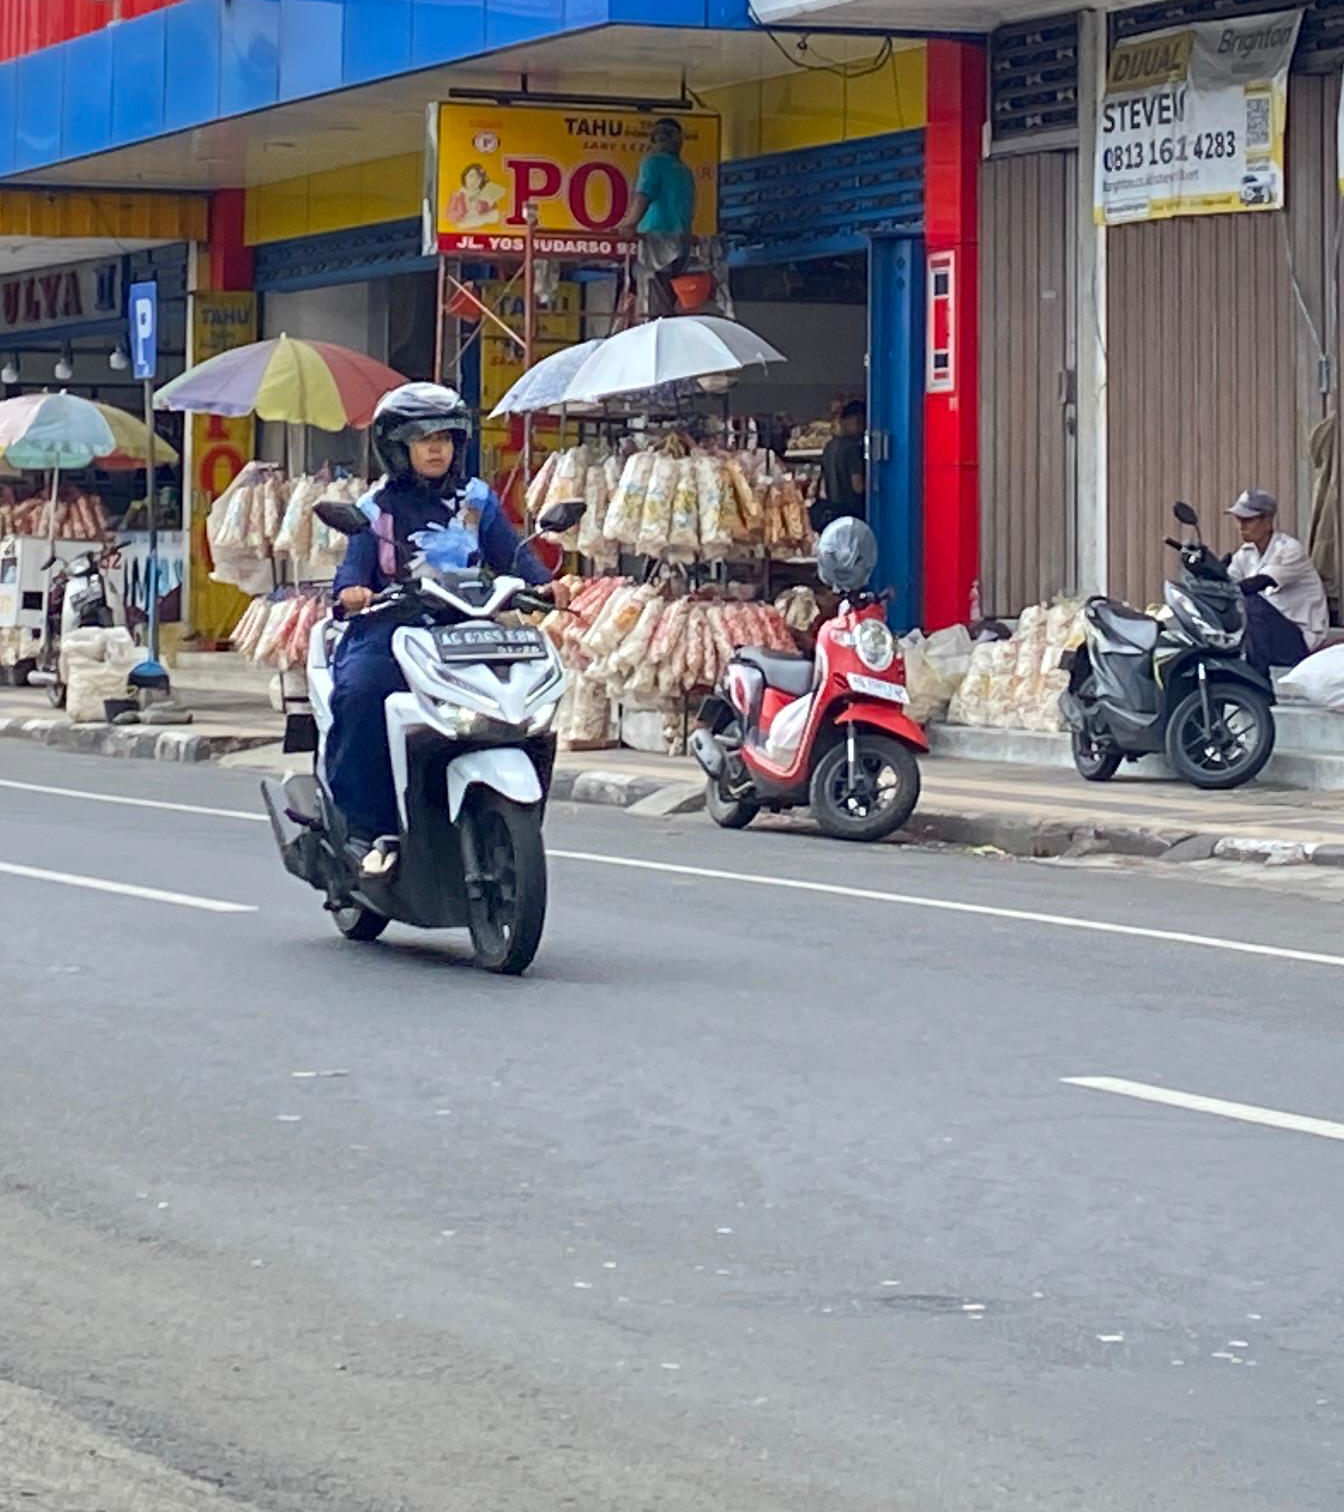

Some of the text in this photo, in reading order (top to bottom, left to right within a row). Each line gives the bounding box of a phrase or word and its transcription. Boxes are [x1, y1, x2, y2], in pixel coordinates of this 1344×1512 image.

[1217, 26, 1292, 58] Brighton
[565, 117, 623, 137] TAHU
[504, 157, 630, 232] PO
[488, 237, 524, 251] YOS
[202, 306, 251, 326] TAHU
[136, 299, 153, 365] P
